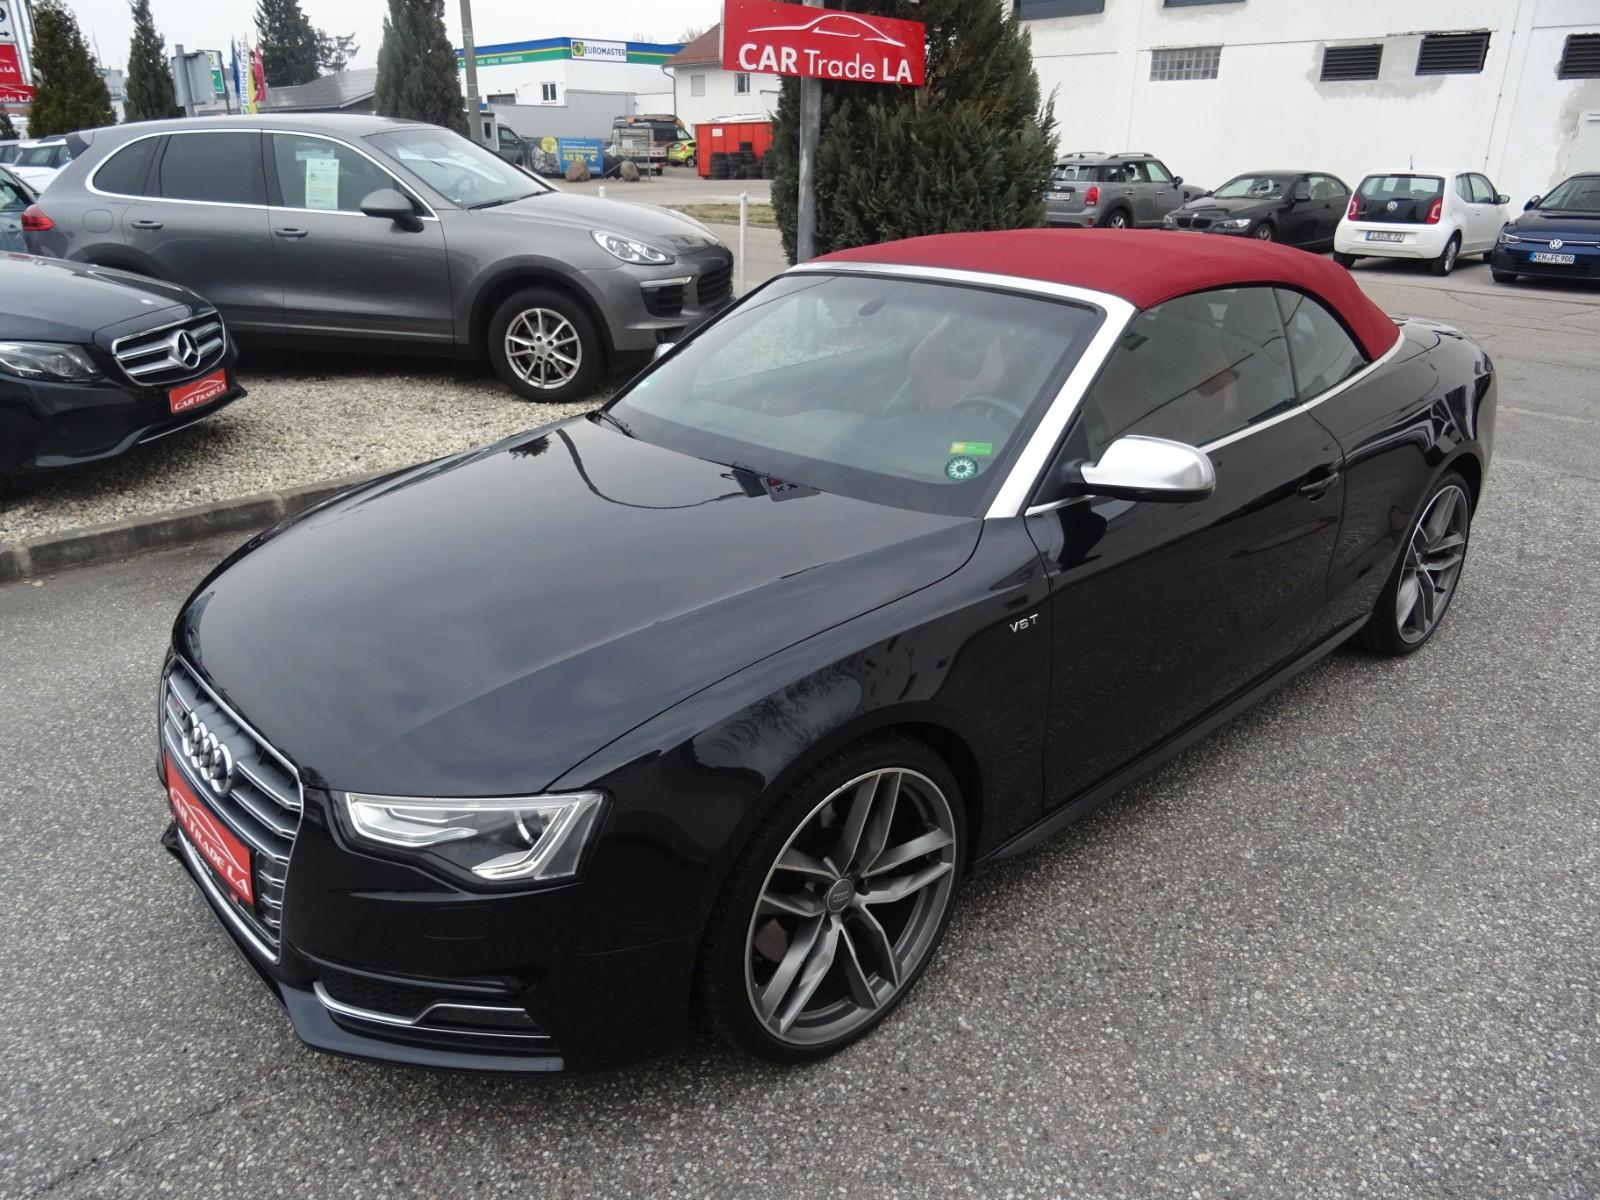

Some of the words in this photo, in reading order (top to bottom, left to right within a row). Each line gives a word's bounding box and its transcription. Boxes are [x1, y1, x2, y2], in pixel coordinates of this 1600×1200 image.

[584, 46, 627, 57] EUROMASTER
[738, 43, 798, 74] CAR
[803, 49, 876, 79] Trade
[882, 57, 913, 83] LA
[174, 397, 194, 410] CAR
[217, 383, 226, 393] LA
[169, 787, 188, 824] CAR
[226, 864, 250, 897] LA
